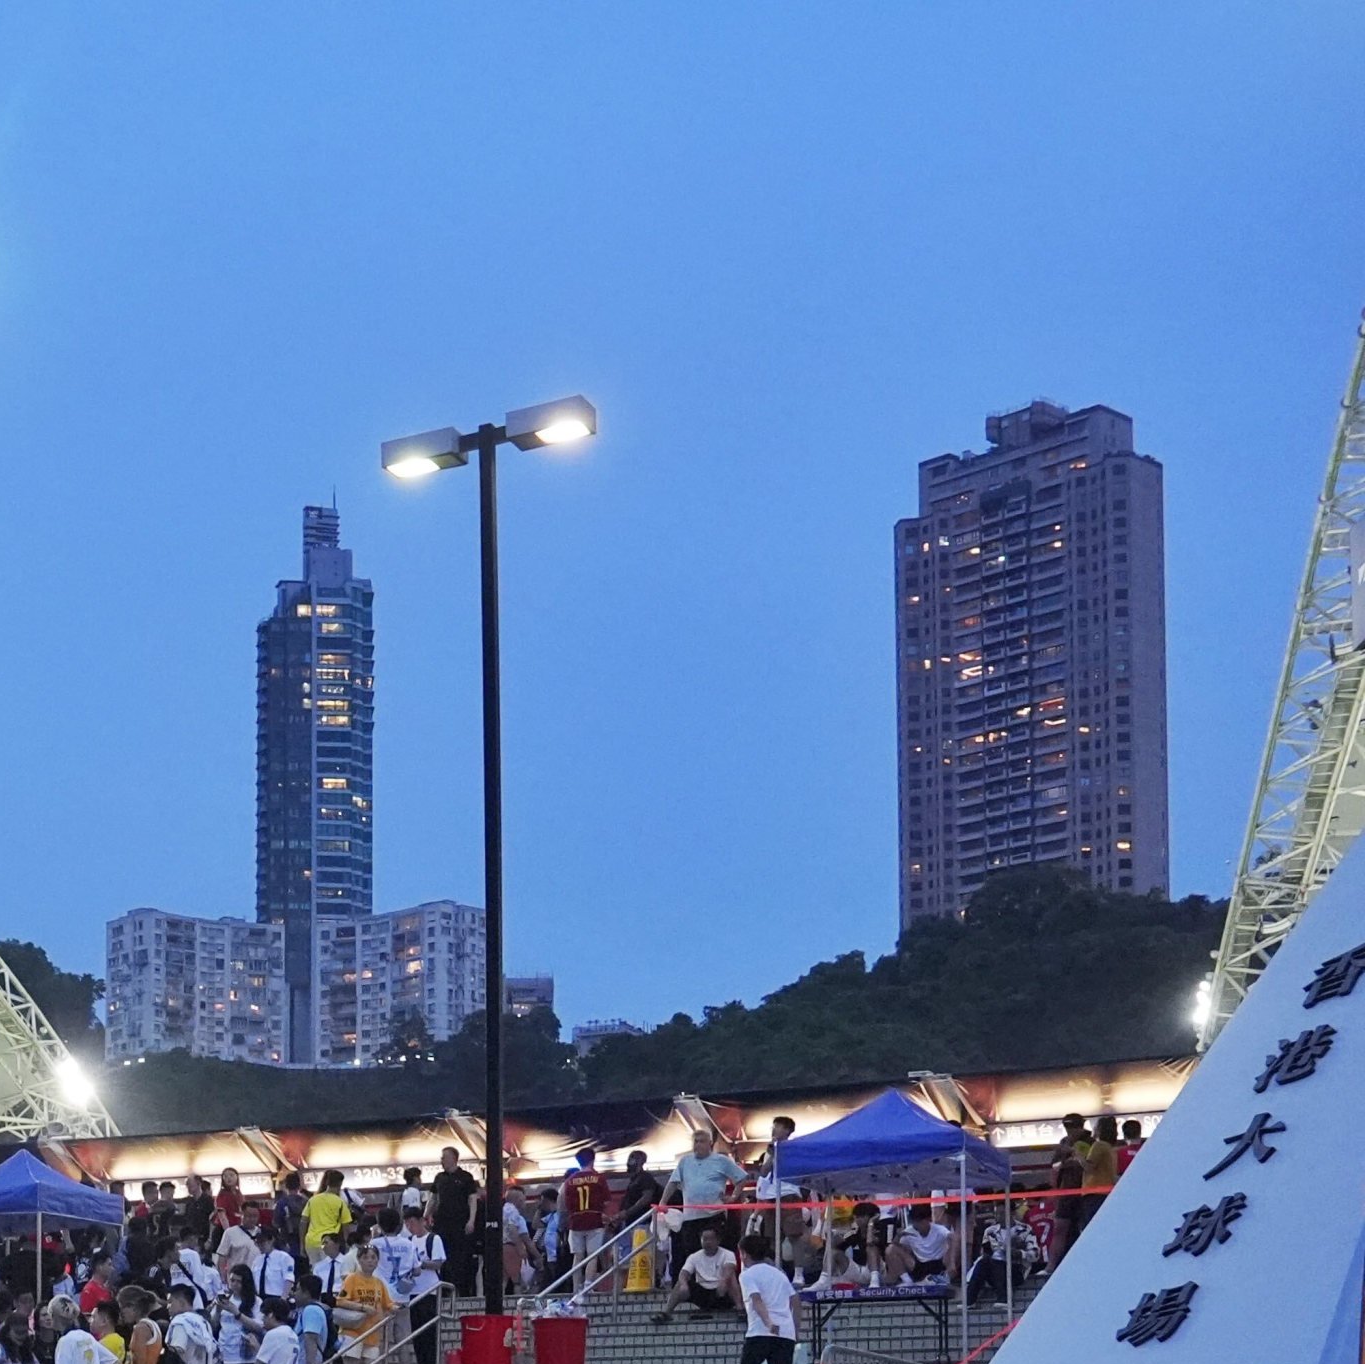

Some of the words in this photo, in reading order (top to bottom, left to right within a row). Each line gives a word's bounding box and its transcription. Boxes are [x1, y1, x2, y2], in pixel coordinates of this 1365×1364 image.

[1116, 943, 1365, 1347] 香港大球場
[859, 1287, 897, 1297] Security
[898, 1286, 927, 1296] Check
